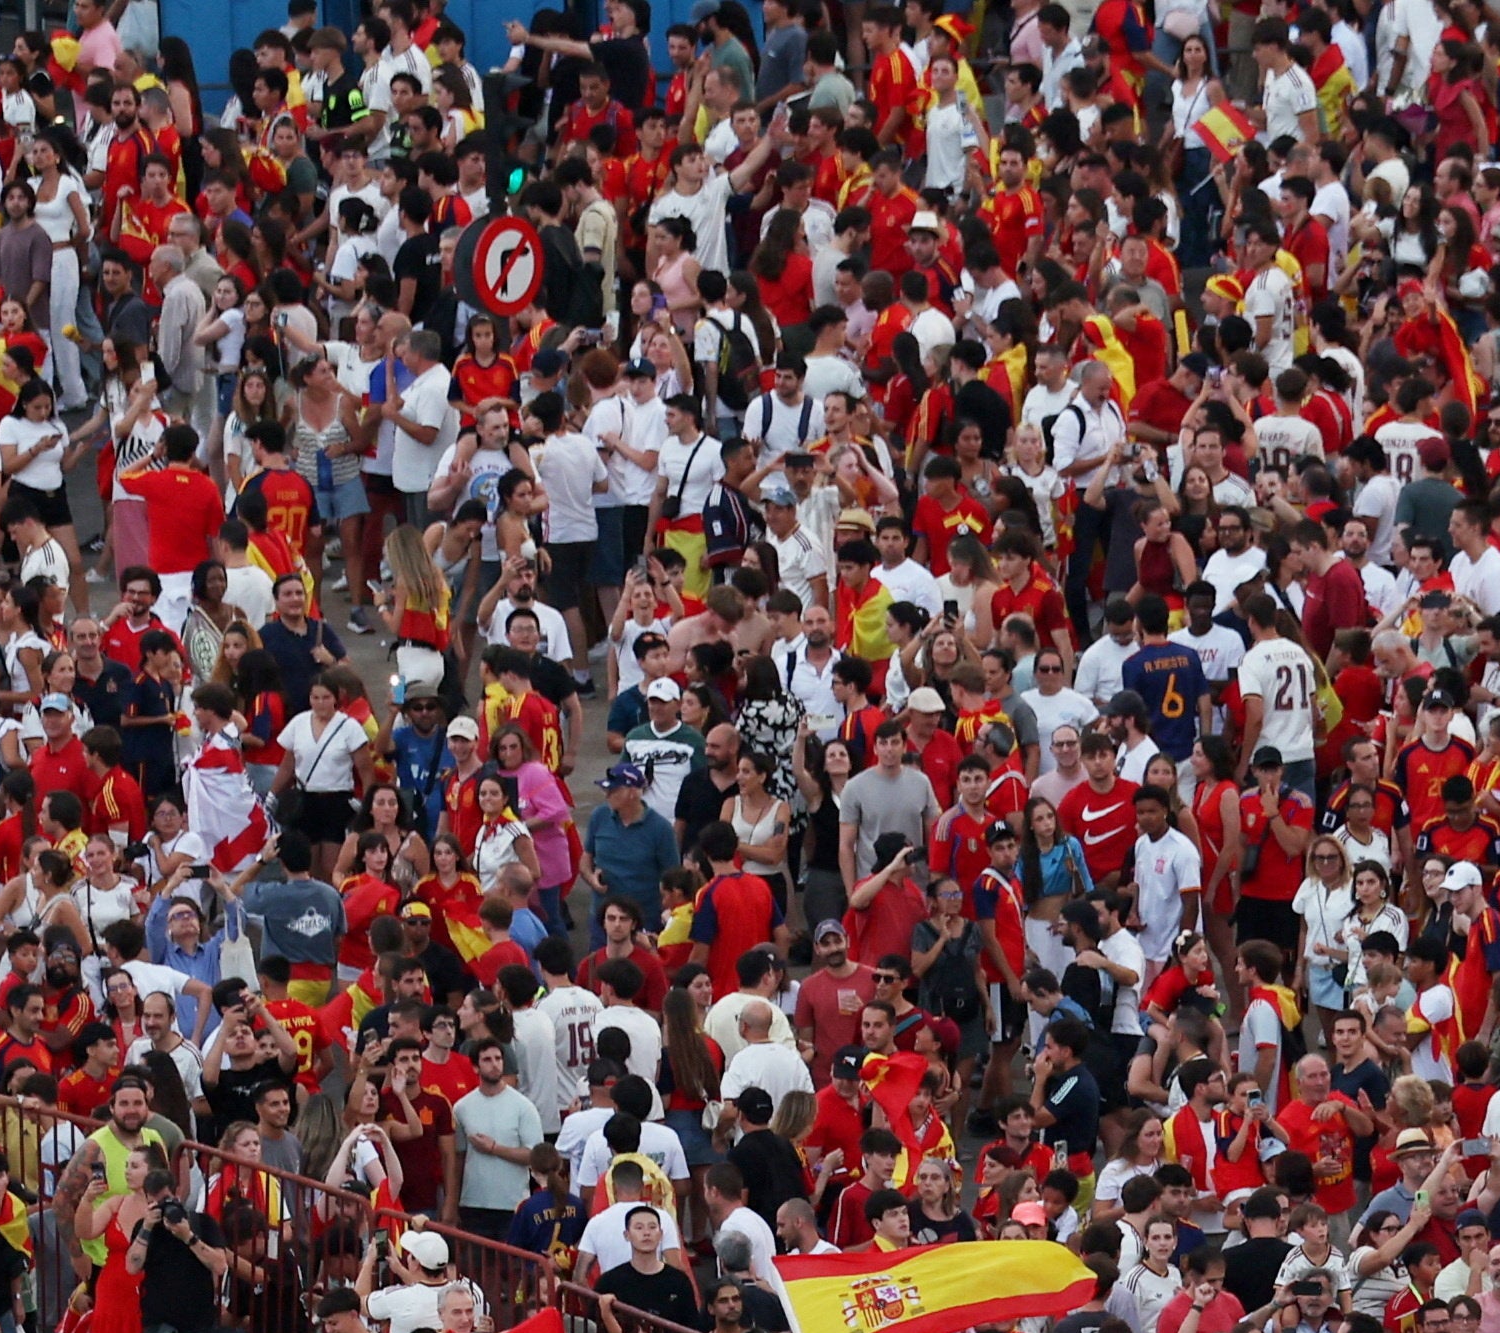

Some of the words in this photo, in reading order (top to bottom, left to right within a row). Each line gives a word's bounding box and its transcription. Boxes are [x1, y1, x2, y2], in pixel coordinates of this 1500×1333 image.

[1161, 674, 1184, 718] 6
[1275, 664, 1315, 711] 21
[292, 1030, 313, 1072] 9
[568, 1022, 597, 1068] 19
